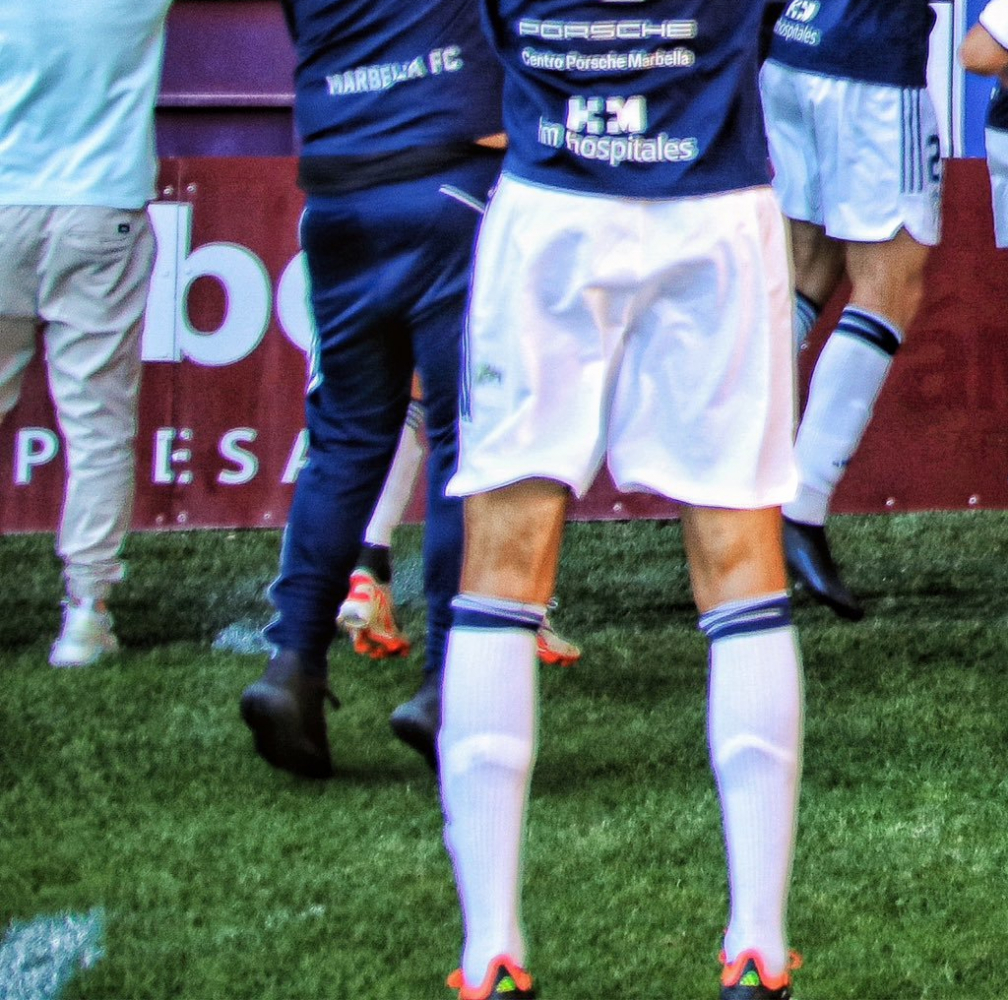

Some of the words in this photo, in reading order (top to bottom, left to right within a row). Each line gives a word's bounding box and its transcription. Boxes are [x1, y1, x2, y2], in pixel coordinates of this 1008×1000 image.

[518, 18, 698, 40] PORSCHE
[429, 45, 464, 75] FC
[521, 47, 566, 70] Centro
[565, 51, 627, 71] Porsche
[627, 47, 695, 68] Marbella
[566, 128, 700, 167] hospitales
